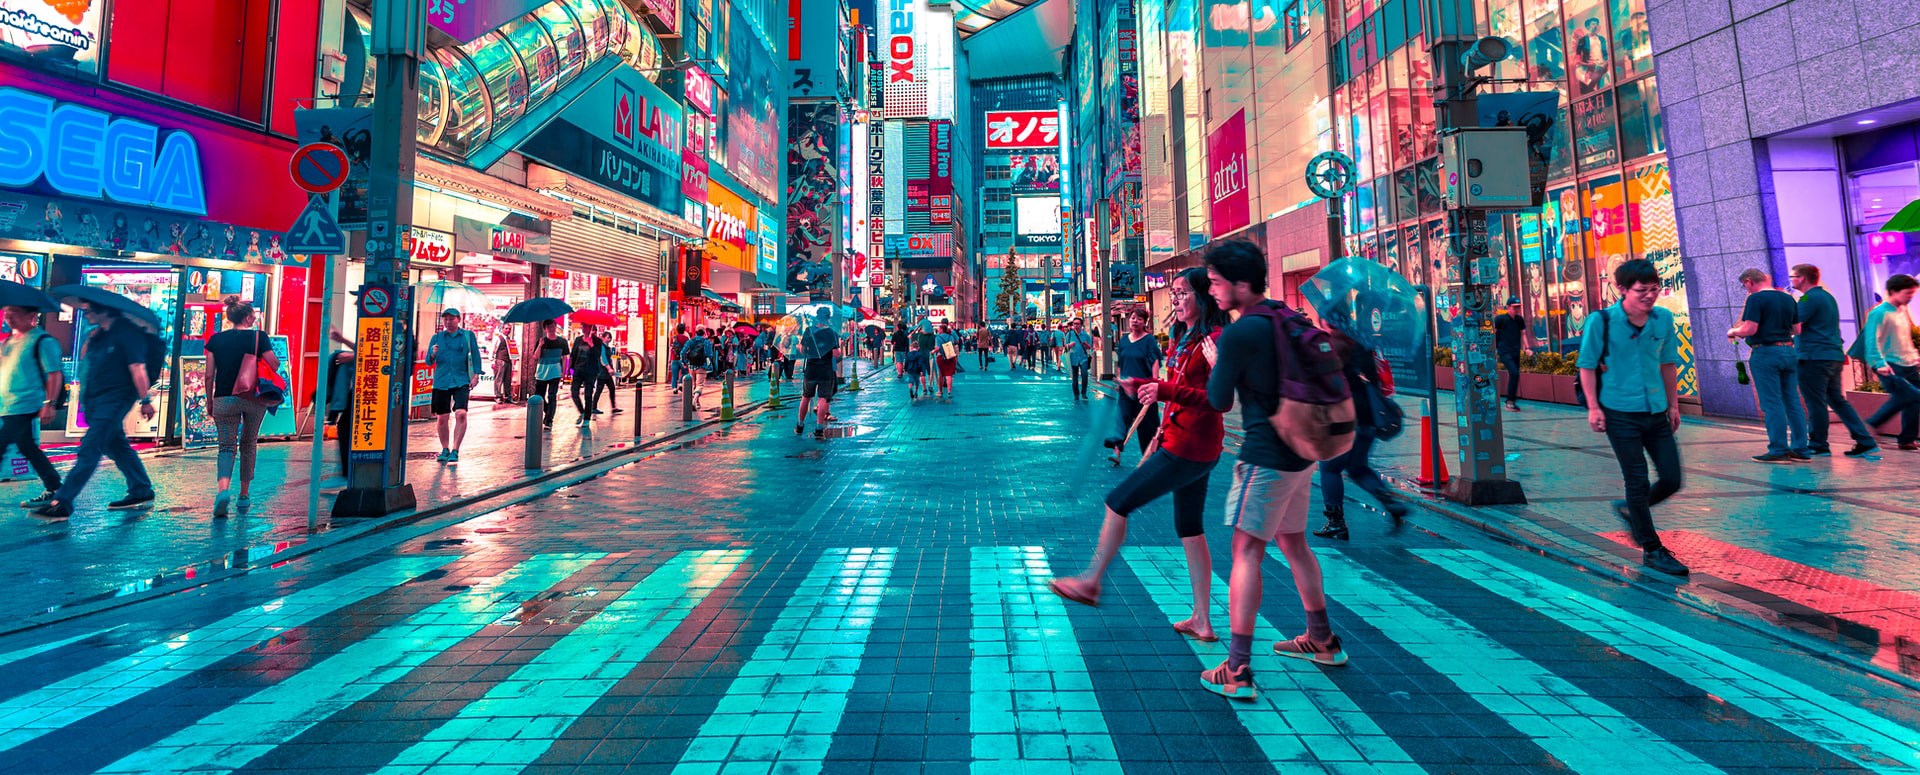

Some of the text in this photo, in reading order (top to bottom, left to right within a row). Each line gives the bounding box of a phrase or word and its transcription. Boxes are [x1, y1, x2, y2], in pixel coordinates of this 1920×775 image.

[638, 94, 680, 156] LABI
[0, 86, 207, 216] SEGA
[600, 149, 651, 197] パソコン館
[637, 140, 680, 175] AKIHABARA
[937, 123, 951, 177] Duty Free
[1213, 152, 1239, 200] atré
[870, 121, 884, 285] ボークス秋葉原ホビー天国
[502, 230, 525, 249] LABI
[1026, 235, 1057, 243] TOKYO
[360, 327, 381, 447] 路上喫煙禁止です。
[416, 368, 434, 381] au
